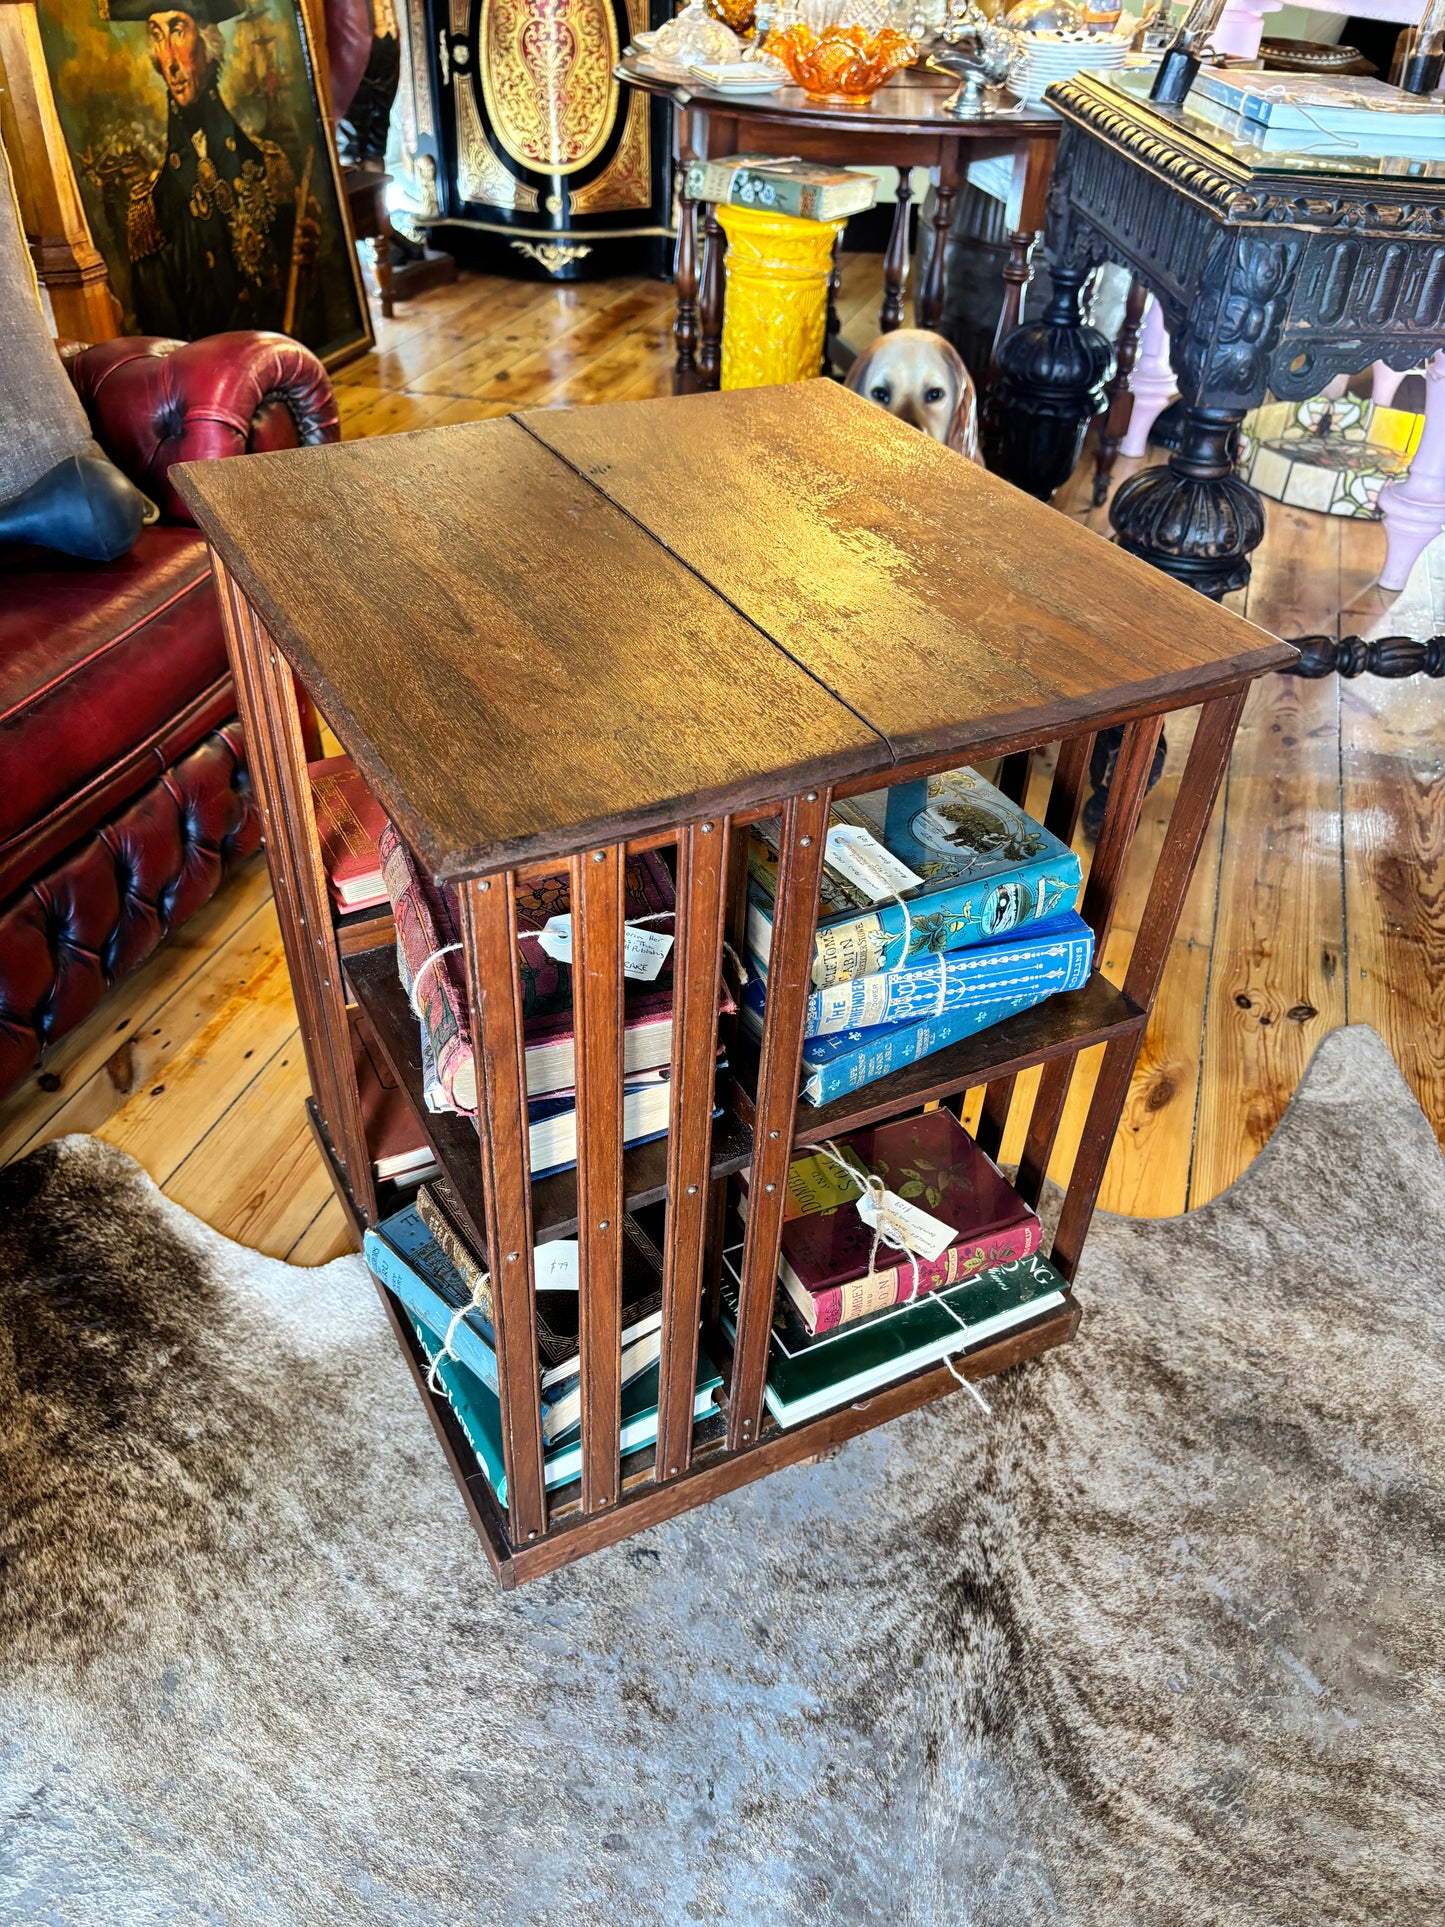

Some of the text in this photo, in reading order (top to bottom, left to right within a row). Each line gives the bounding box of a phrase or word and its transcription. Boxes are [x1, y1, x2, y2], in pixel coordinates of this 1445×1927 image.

[818, 961, 838, 990] NCLE
[1069, 946, 1083, 989] COLLINS
[825, 1000, 846, 1024] THE
[811, 1171, 830, 1189] AND
